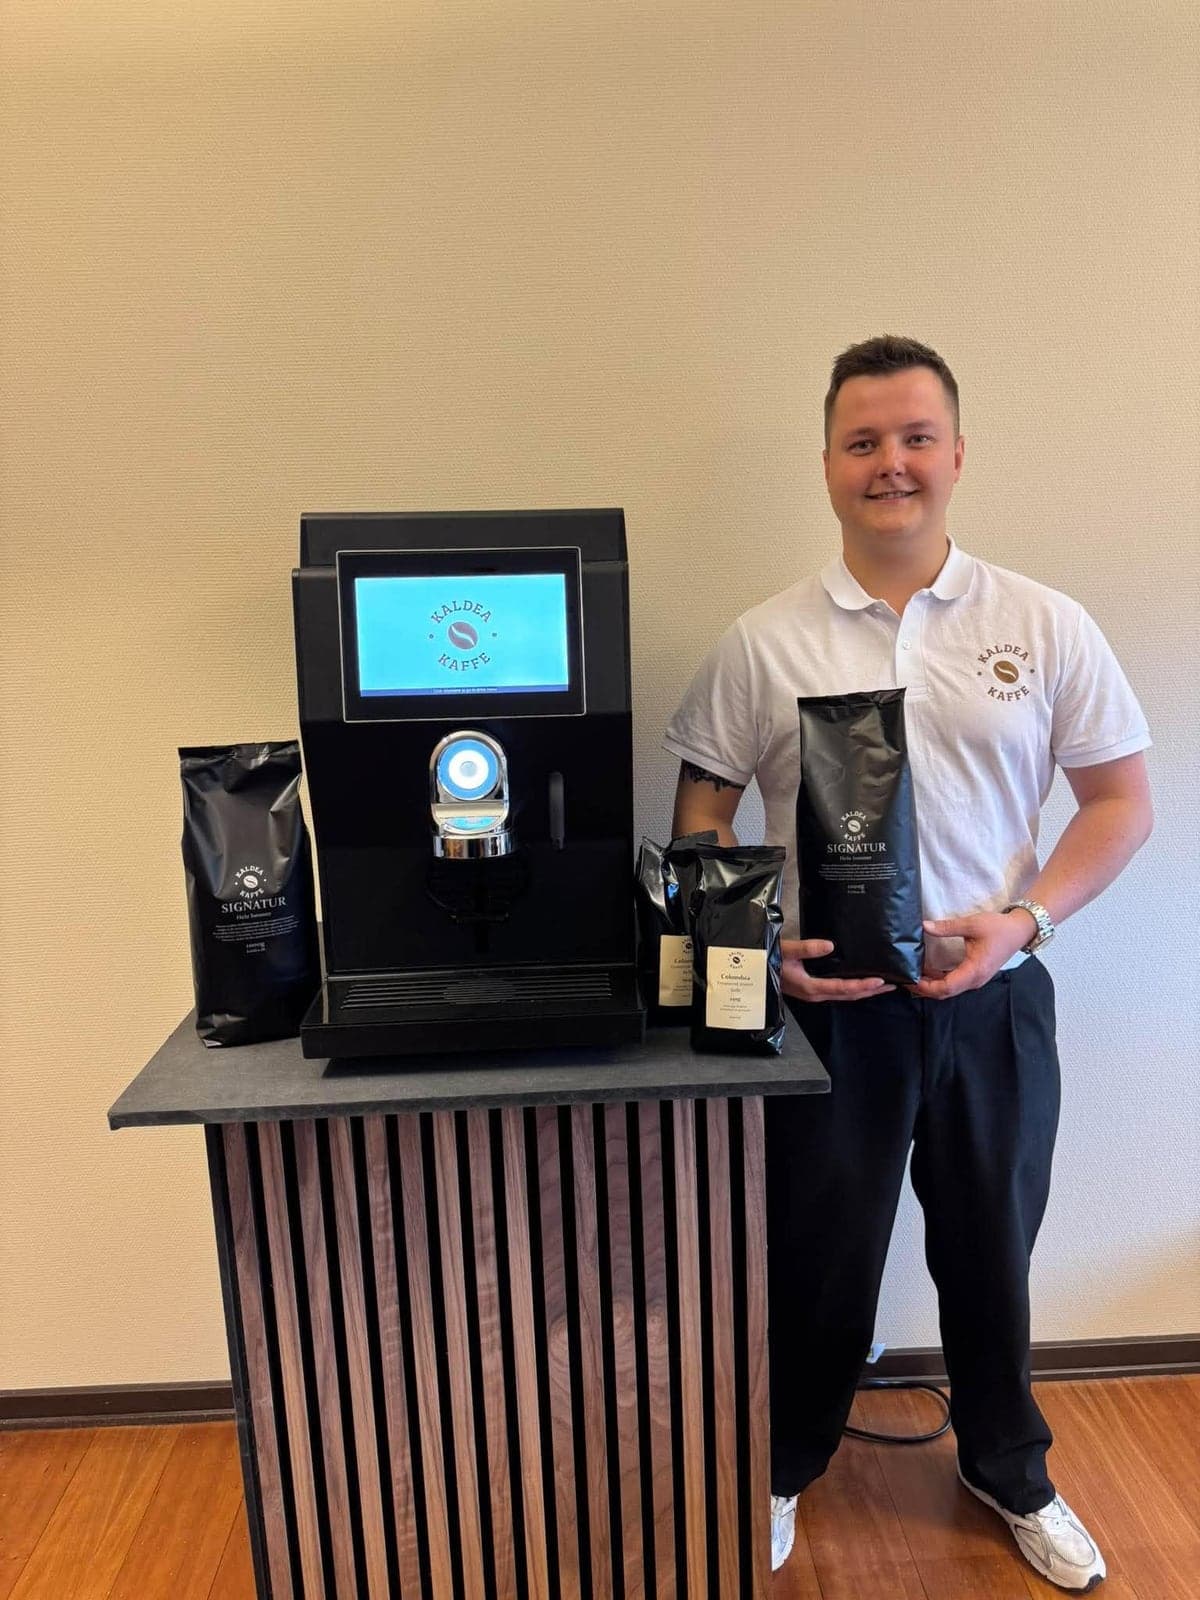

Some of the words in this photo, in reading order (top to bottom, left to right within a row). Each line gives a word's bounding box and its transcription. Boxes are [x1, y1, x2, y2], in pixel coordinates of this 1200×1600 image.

[430, 600, 493, 625] KALDEA
[977, 644, 1030, 664] KALDEA
[437, 652, 492, 672] KAFFE
[987, 685, 1030, 702] KAFFE
[840, 810, 867, 822] KALDEA
[844, 832, 866, 842] KAFFE
[827, 842, 887, 854] SIGNATUR
[235, 865, 265, 879] KALDEA
[239, 888, 265, 899] KAFFE
[221, 896, 287, 914] SIGNATUR
